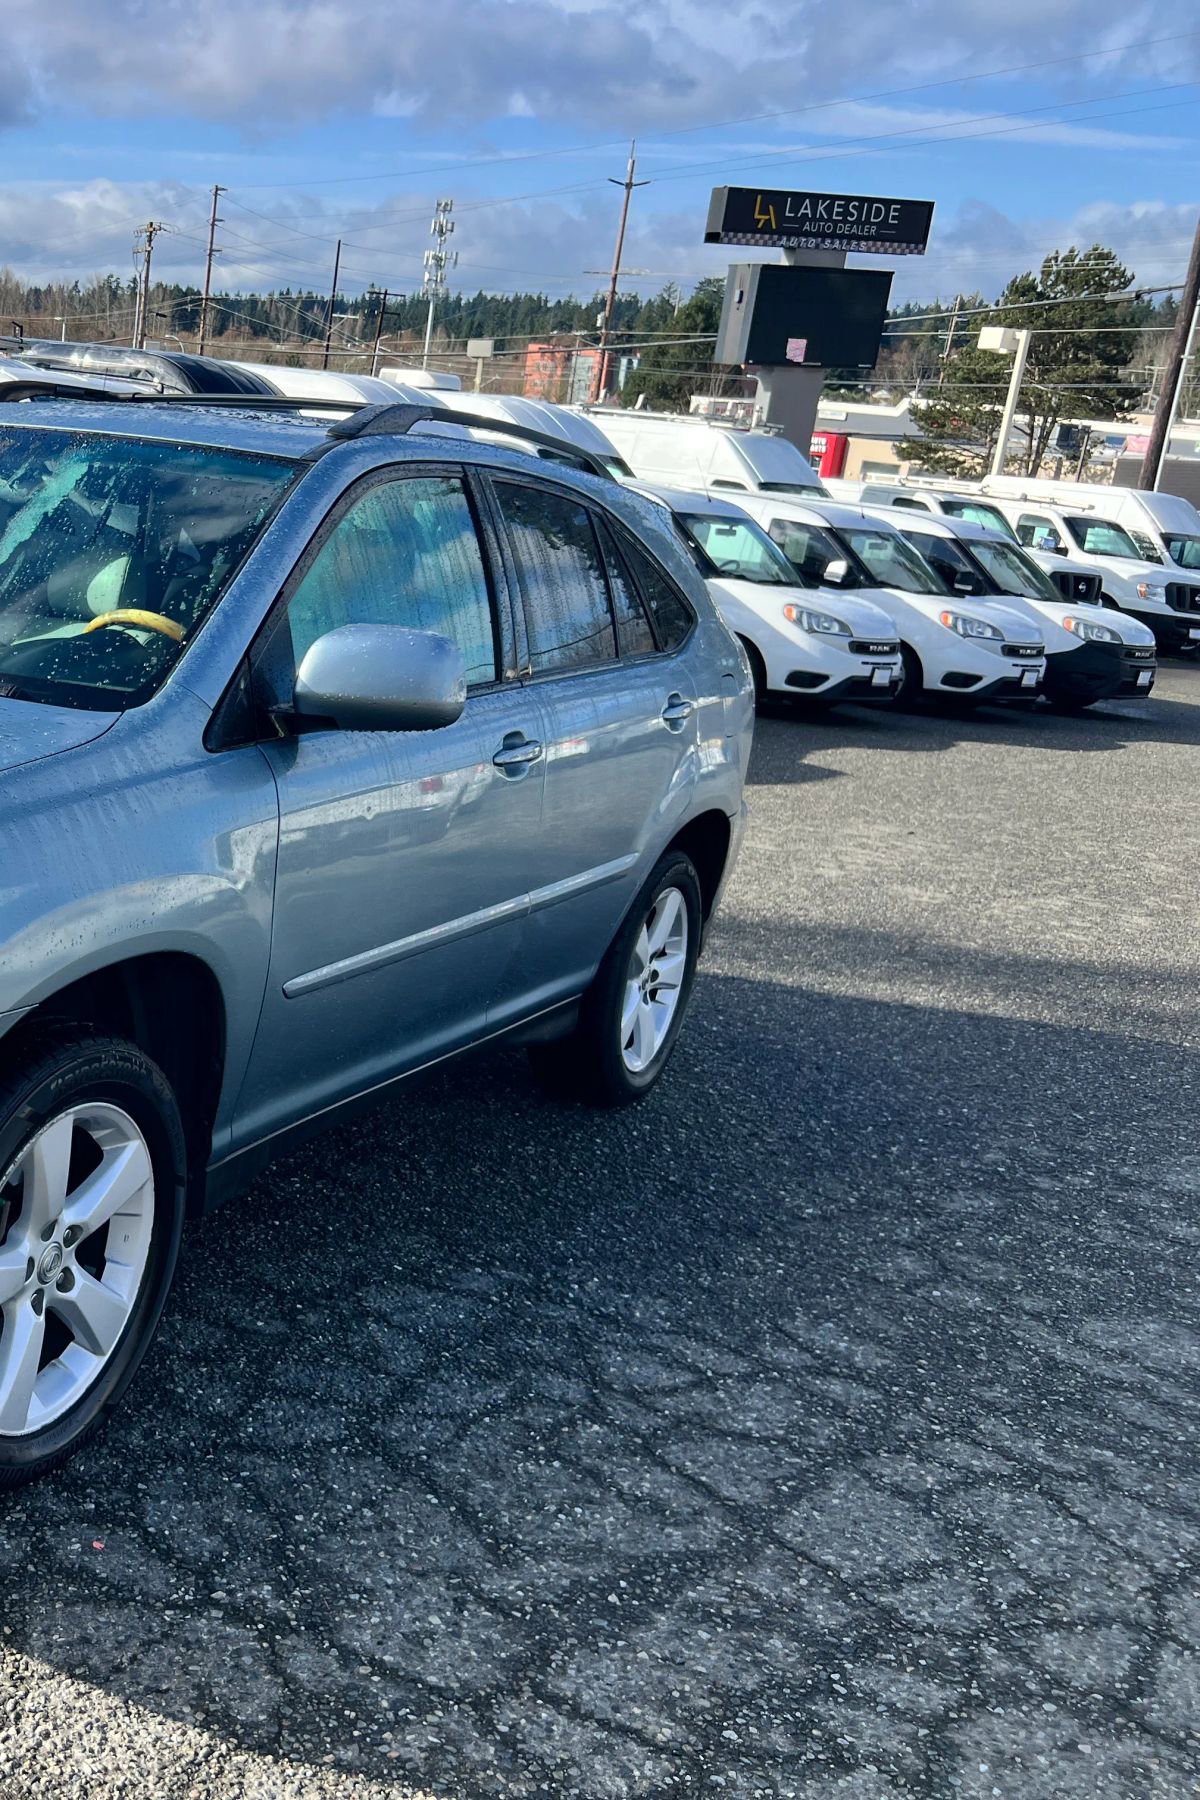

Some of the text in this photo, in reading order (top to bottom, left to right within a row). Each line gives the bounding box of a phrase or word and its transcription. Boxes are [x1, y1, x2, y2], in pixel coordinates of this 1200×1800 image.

[785, 197, 901, 224] LAKESIDE
[802, 221, 877, 236] AUTO DEALER
[779, 235, 868, 251] AUTO SALES
